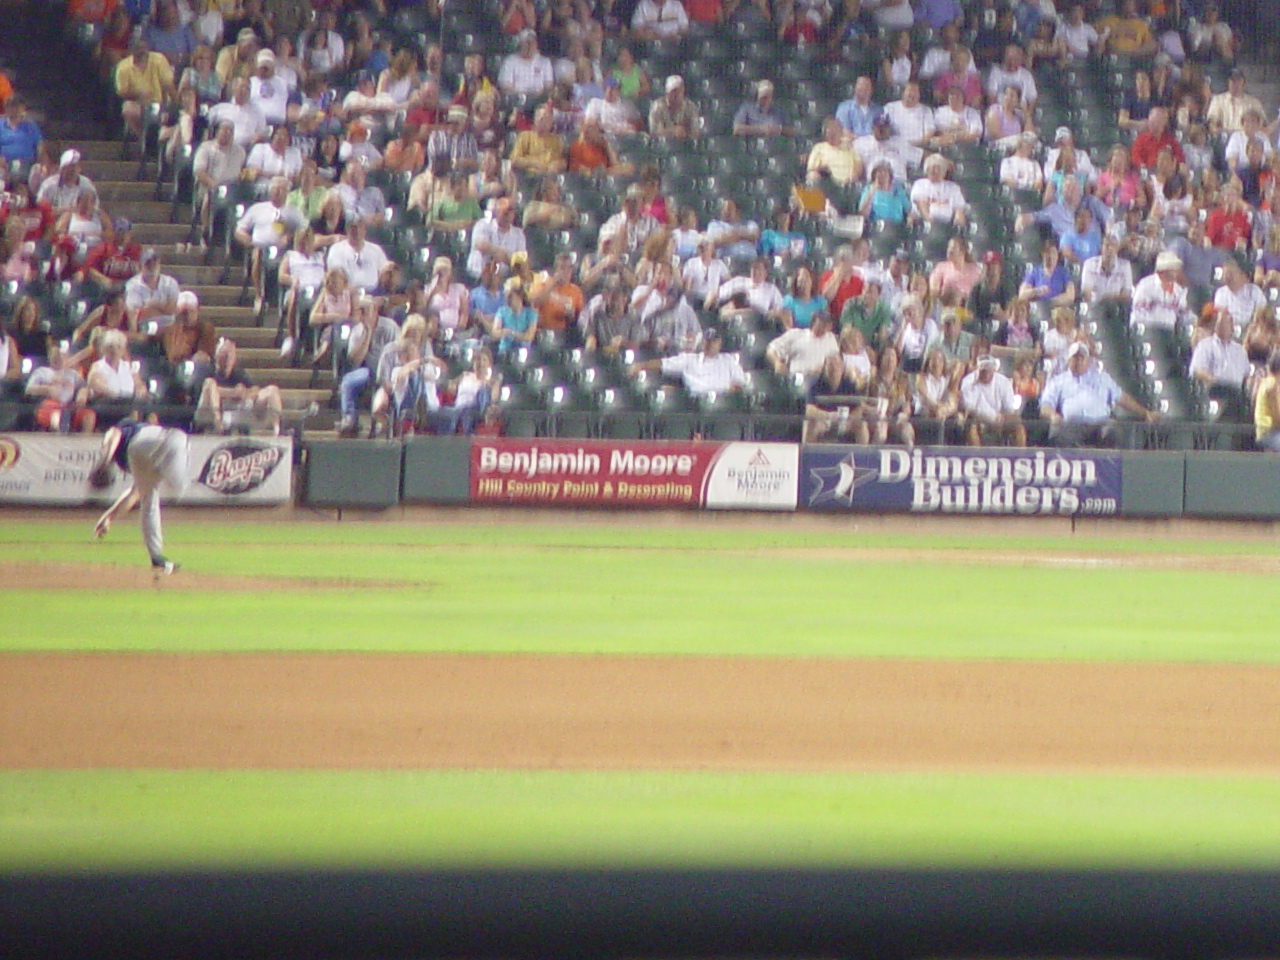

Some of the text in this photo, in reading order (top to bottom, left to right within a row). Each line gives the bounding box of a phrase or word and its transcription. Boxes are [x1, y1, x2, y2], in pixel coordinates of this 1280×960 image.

[480, 447, 693, 477] Benjamin Moore
[878, 449, 1097, 486] Dimension
[727, 467, 790, 483] Benjamin
[737, 478, 780, 491] Moore
[478, 479, 502, 494] Hill
[506, 480, 559, 499] Country
[618, 481, 692, 501] Decorating
